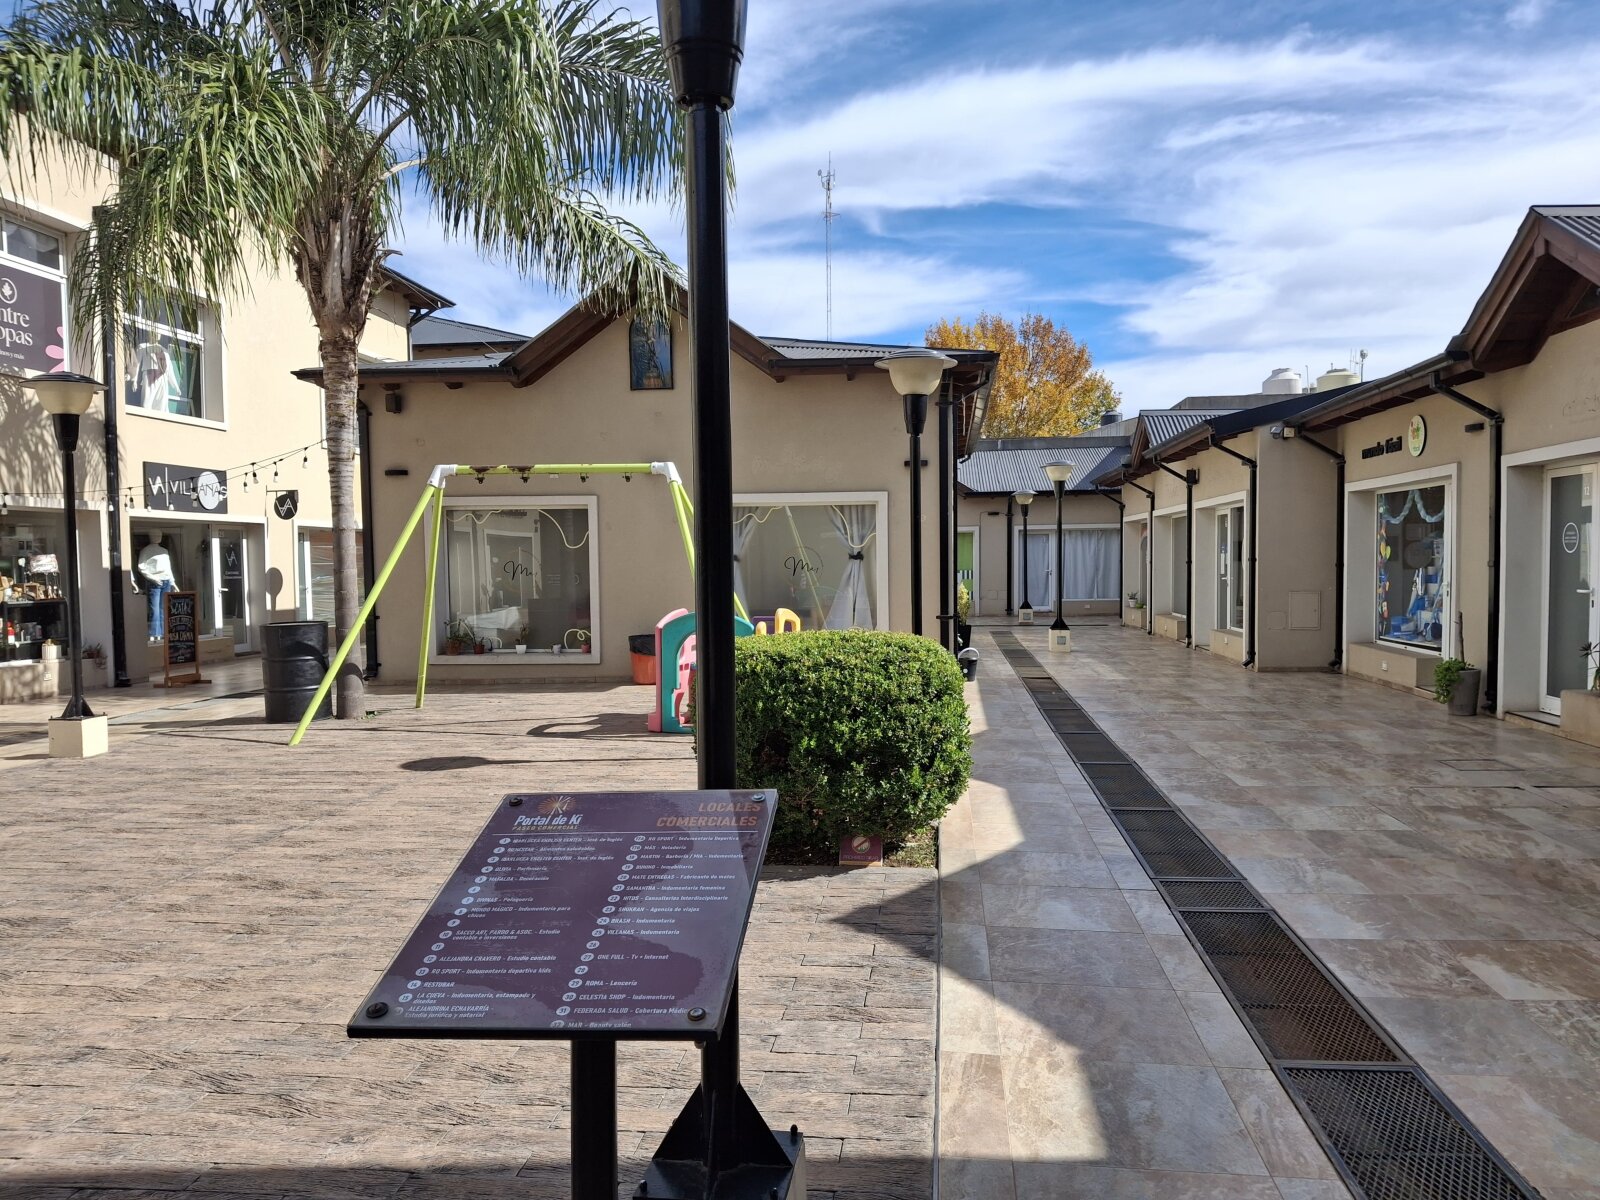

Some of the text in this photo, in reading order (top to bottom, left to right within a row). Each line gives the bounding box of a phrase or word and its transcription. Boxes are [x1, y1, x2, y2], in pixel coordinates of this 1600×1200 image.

[0, 308, 30, 328] ntre
[0, 326, 33, 347] opas
[698, 802, 760, 812] LOCALES
[514, 814, 584, 826] Portal de Ki
[656, 816, 758, 827] COMERCIALES
